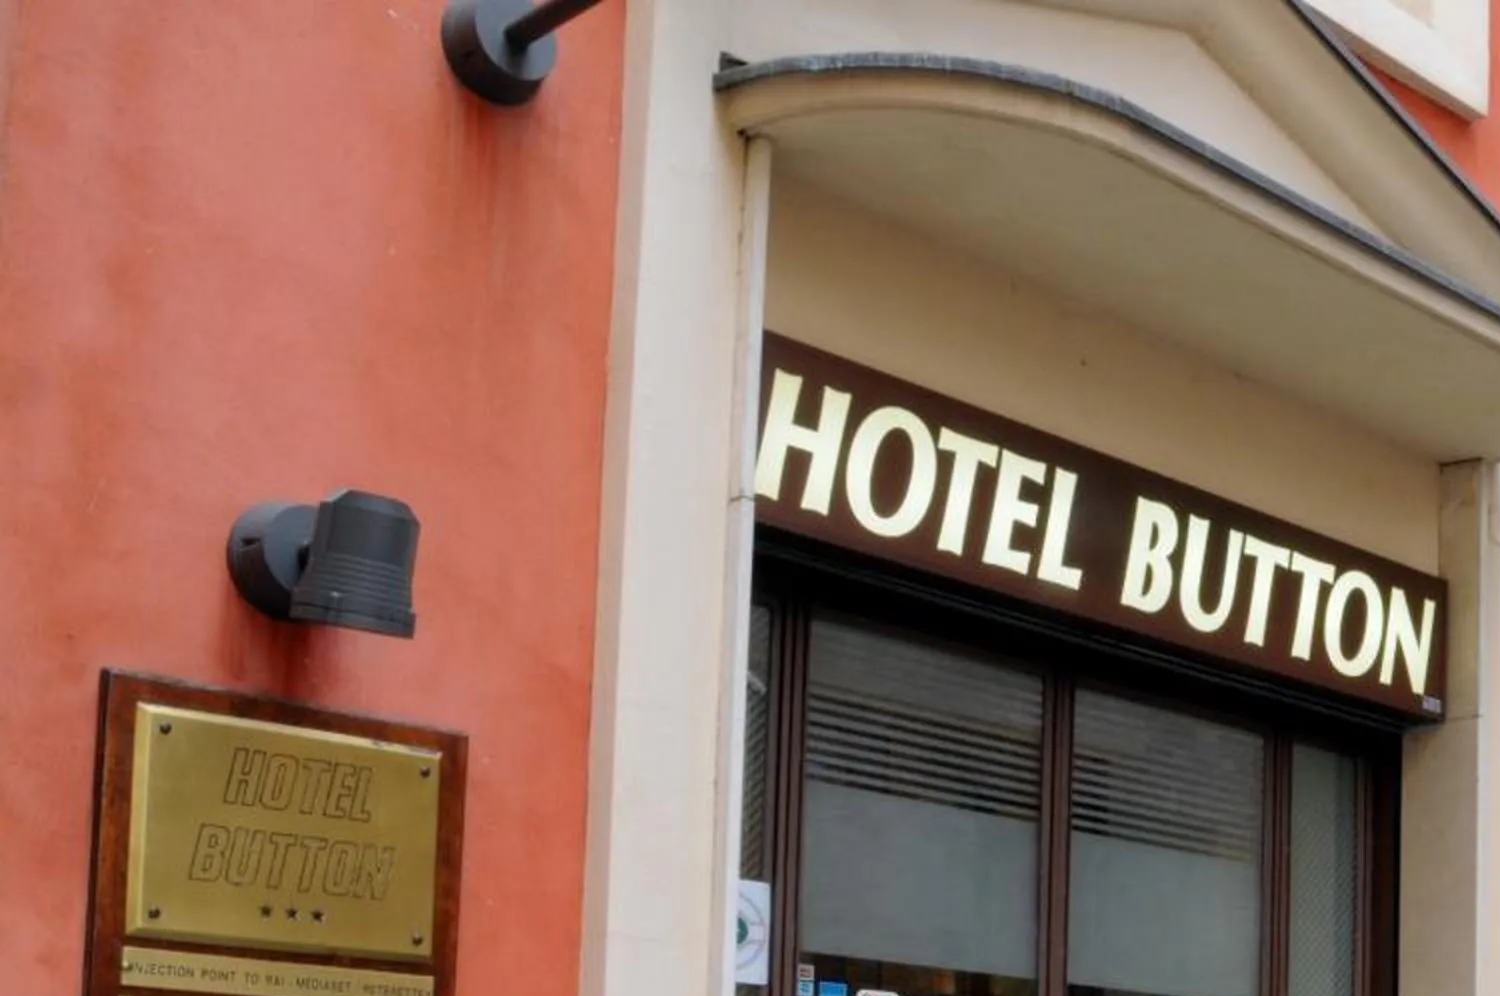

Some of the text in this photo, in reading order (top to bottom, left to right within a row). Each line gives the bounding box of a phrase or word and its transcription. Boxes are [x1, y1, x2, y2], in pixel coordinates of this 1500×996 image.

[754, 368, 1436, 696] HOTEL BUTTON
[222, 746, 373, 824] HOTEL
[188, 822, 397, 902] BUTTON
[200, 969, 236, 984] POINT
[245, 973, 260, 986] TO
